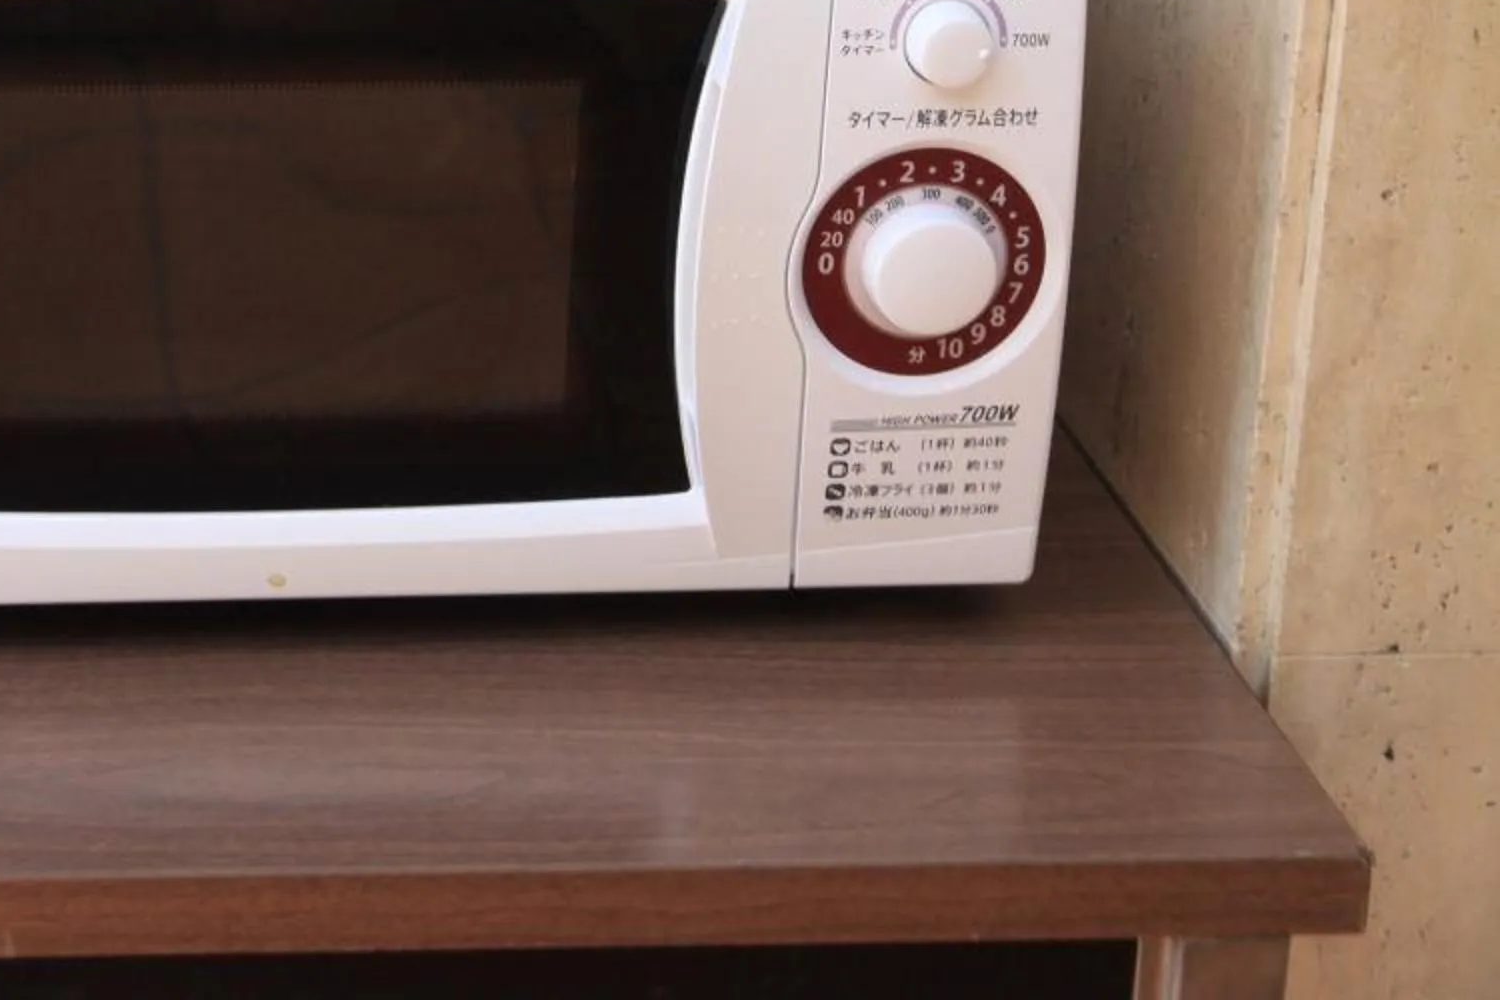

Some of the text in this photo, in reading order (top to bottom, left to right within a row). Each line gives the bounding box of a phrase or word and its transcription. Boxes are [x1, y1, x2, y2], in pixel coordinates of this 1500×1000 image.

[841, 29, 884, 42] キッチン
[1012, 33, 1050, 48] 700W
[840, 44, 884, 56] タイマー
[818, 160, 1031, 364] 0 20 40 1 2 3 4 5 6 7 8 9 10 分
[881, 404, 1021, 425] HIGH POWER 700W
[853, 438, 900, 454] ごはん
[848, 483, 913, 498] 冷凍フライ
